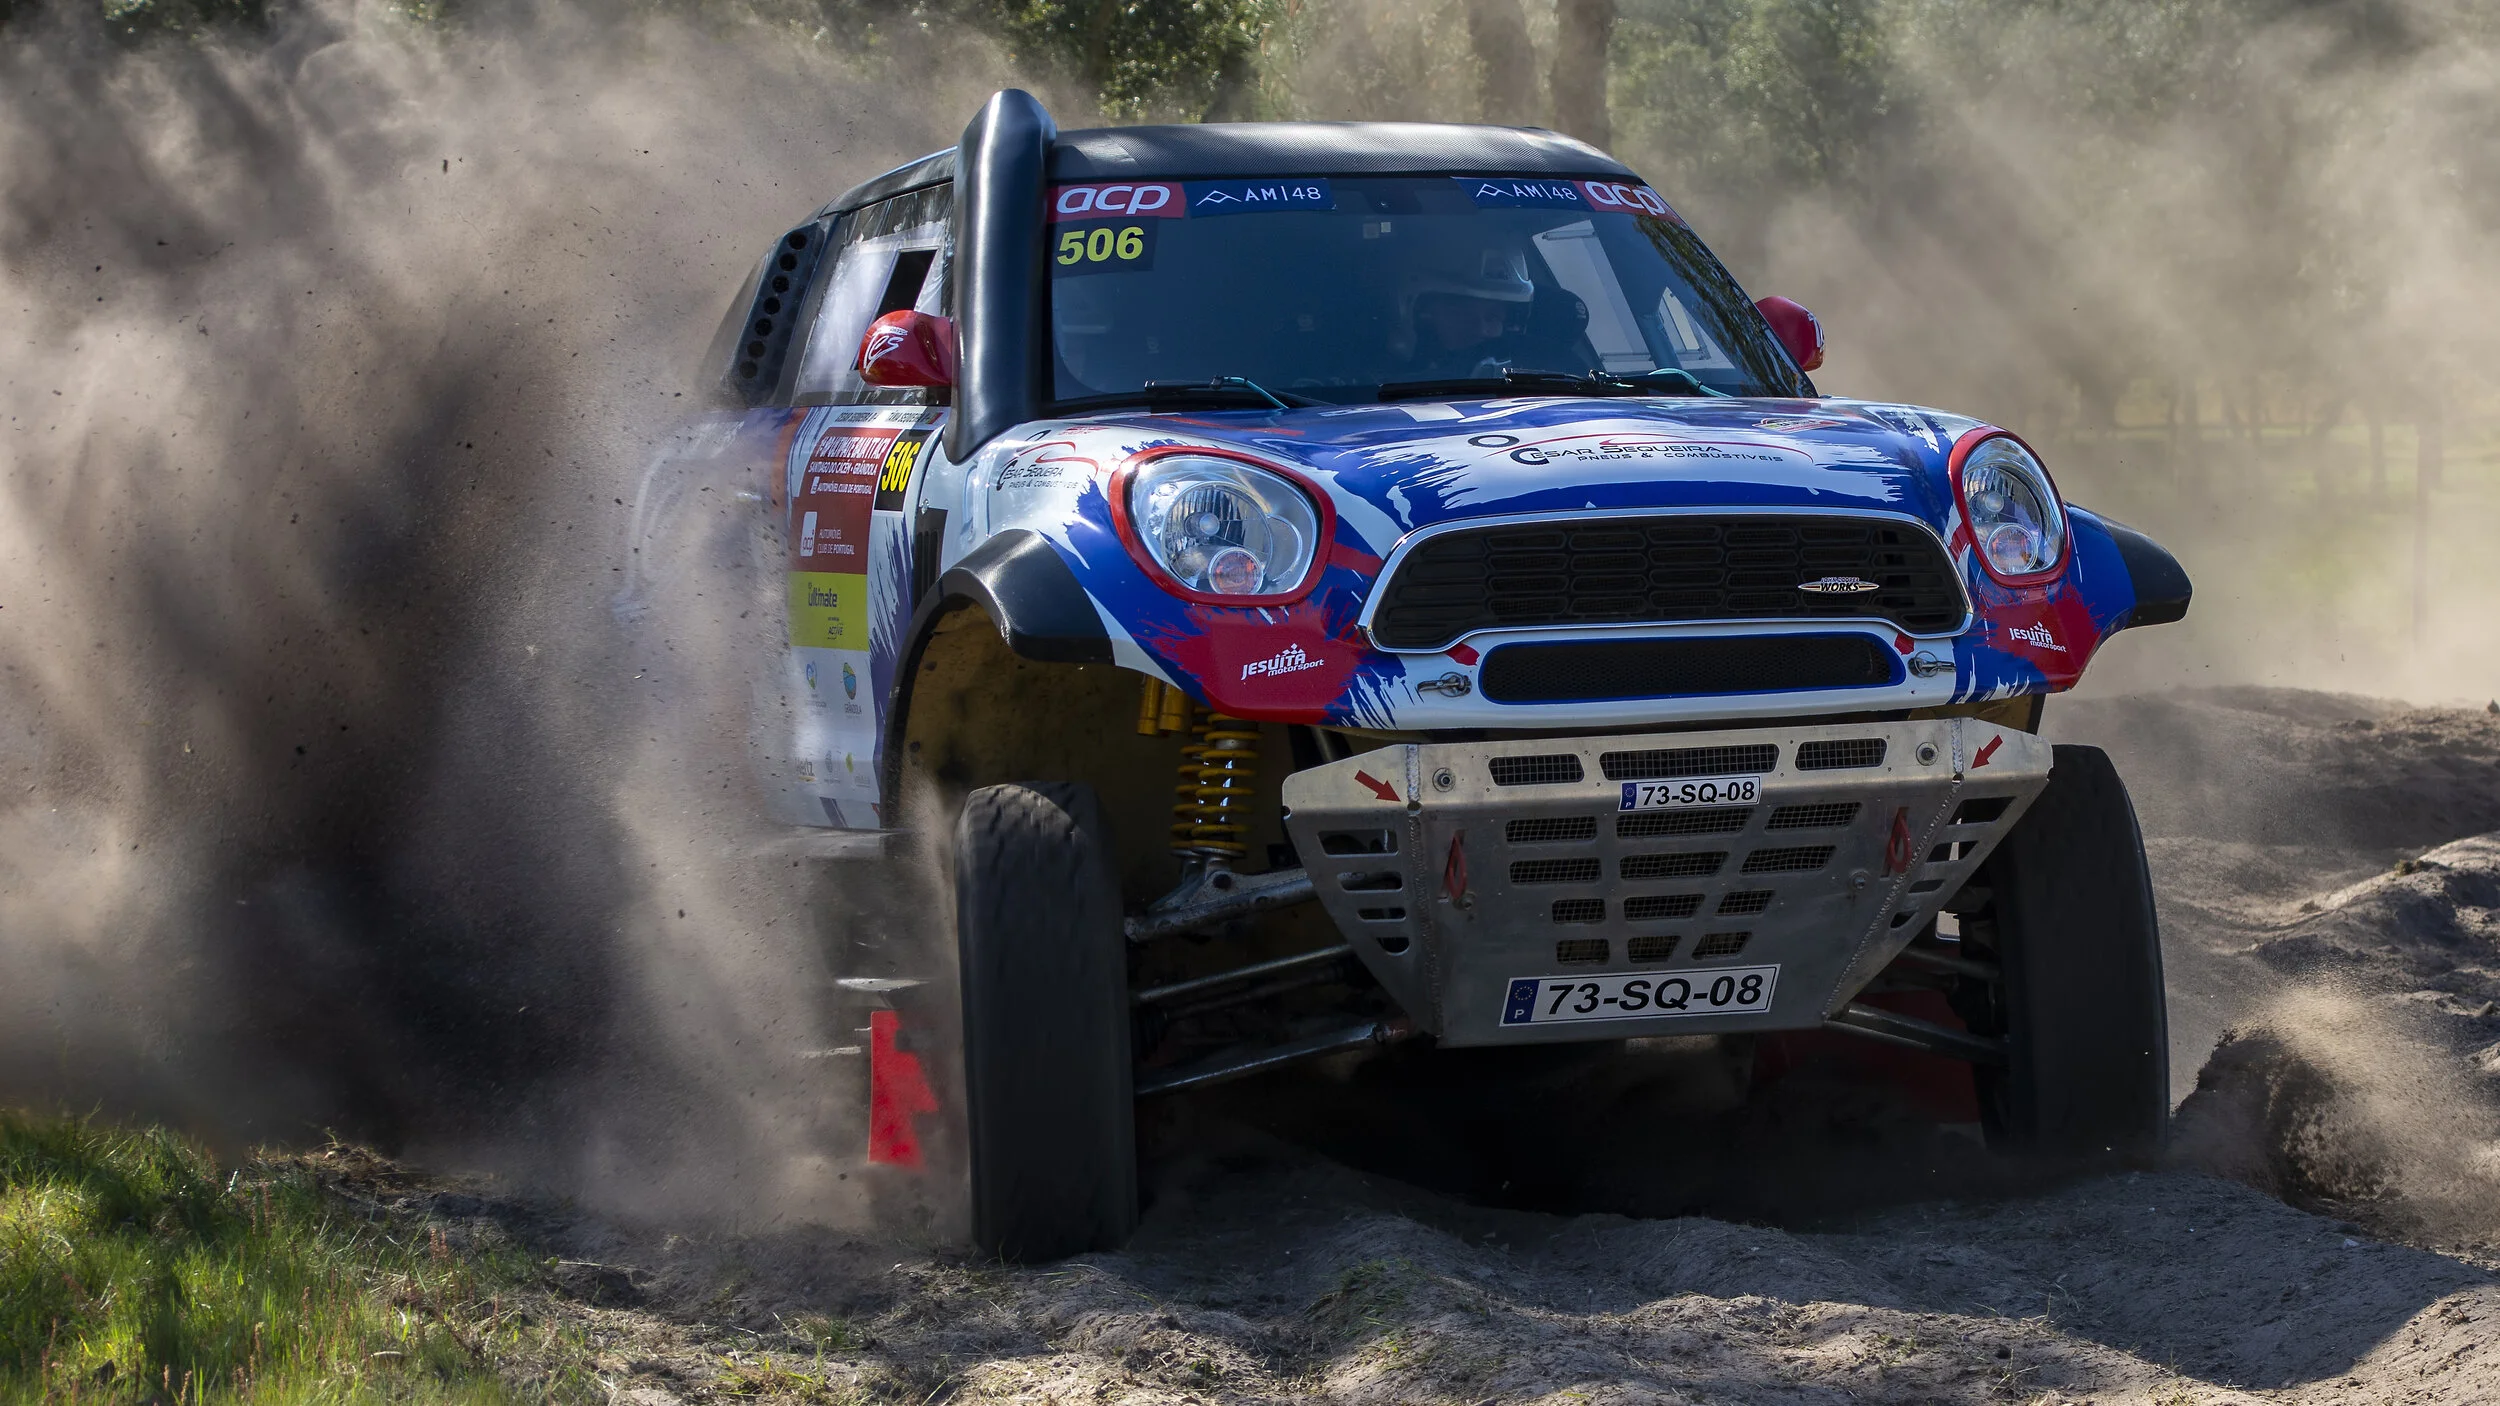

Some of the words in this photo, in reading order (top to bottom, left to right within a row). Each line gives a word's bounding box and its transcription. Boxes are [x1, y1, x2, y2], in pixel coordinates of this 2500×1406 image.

[1056, 185, 1171, 215] acp
[1584, 180, 1667, 217] acp
[1056, 226, 1145, 266] 506
[881, 441, 921, 492] 506
[1577, 454, 1632, 462] PNEUS
[1641, 452, 1654, 460] &
[808, 587, 838, 608] ultimate
[1820, 582, 1860, 592] WORKS
[2029, 640, 2067, 653] motorsport
[1267, 659, 1325, 677] motorsport
[1641, 780, 1756, 806] 73-SQ-08
[1547, 974, 1765, 1015] 73-SQ-08
[1513, 1008, 1525, 1020] P
